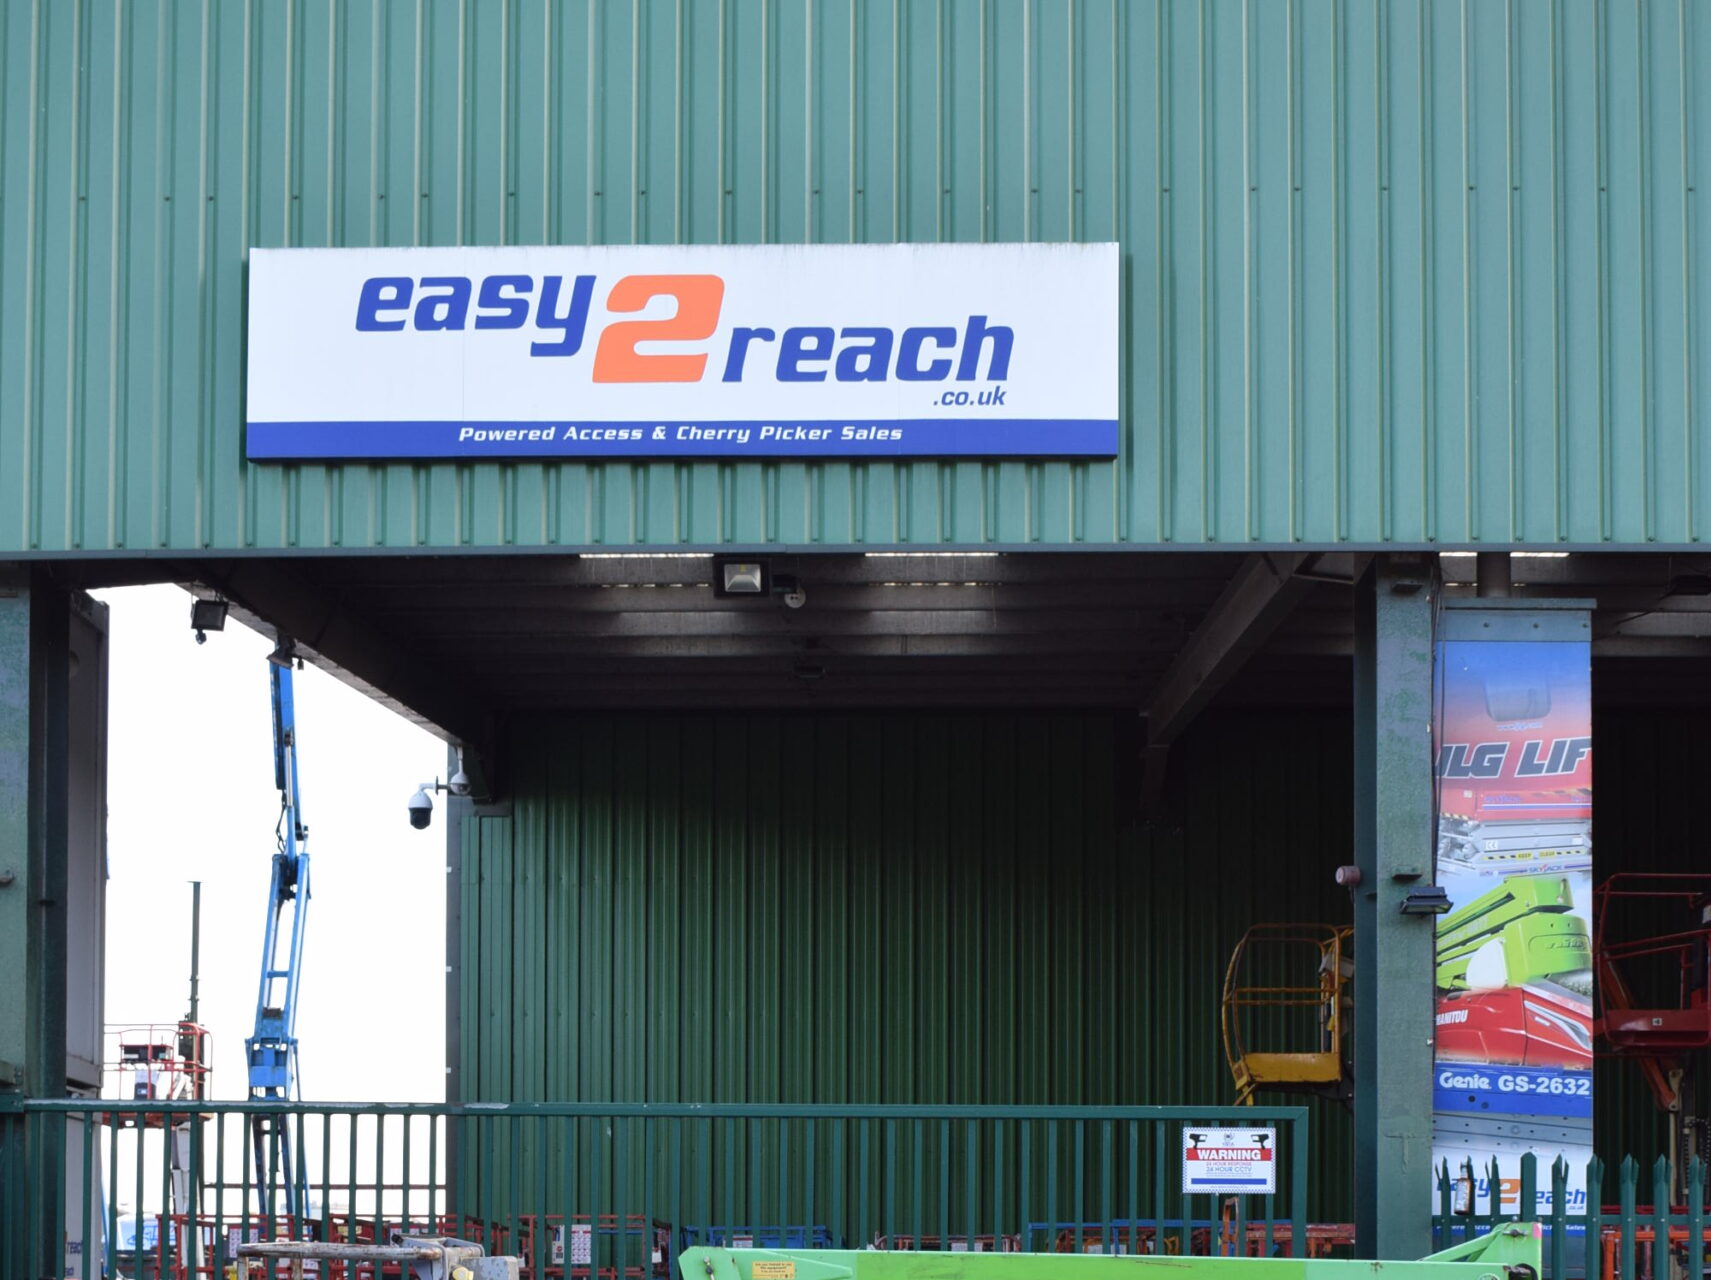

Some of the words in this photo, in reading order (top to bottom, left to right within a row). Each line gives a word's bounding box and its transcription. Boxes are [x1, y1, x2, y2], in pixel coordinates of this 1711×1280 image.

[932, 385, 1007, 406] .co.uk
[459, 426, 556, 442] Powered
[563, 426, 643, 440] Access
[652, 426, 667, 440] &
[676, 426, 751, 444] Cherry
[759, 426, 833, 441] Picker
[841, 426, 903, 441] Sales
[1439, 1071, 1491, 1089] Genie
[1498, 1074, 1590, 1096] GS-2632
[1197, 1149, 1262, 1160] WARNING
